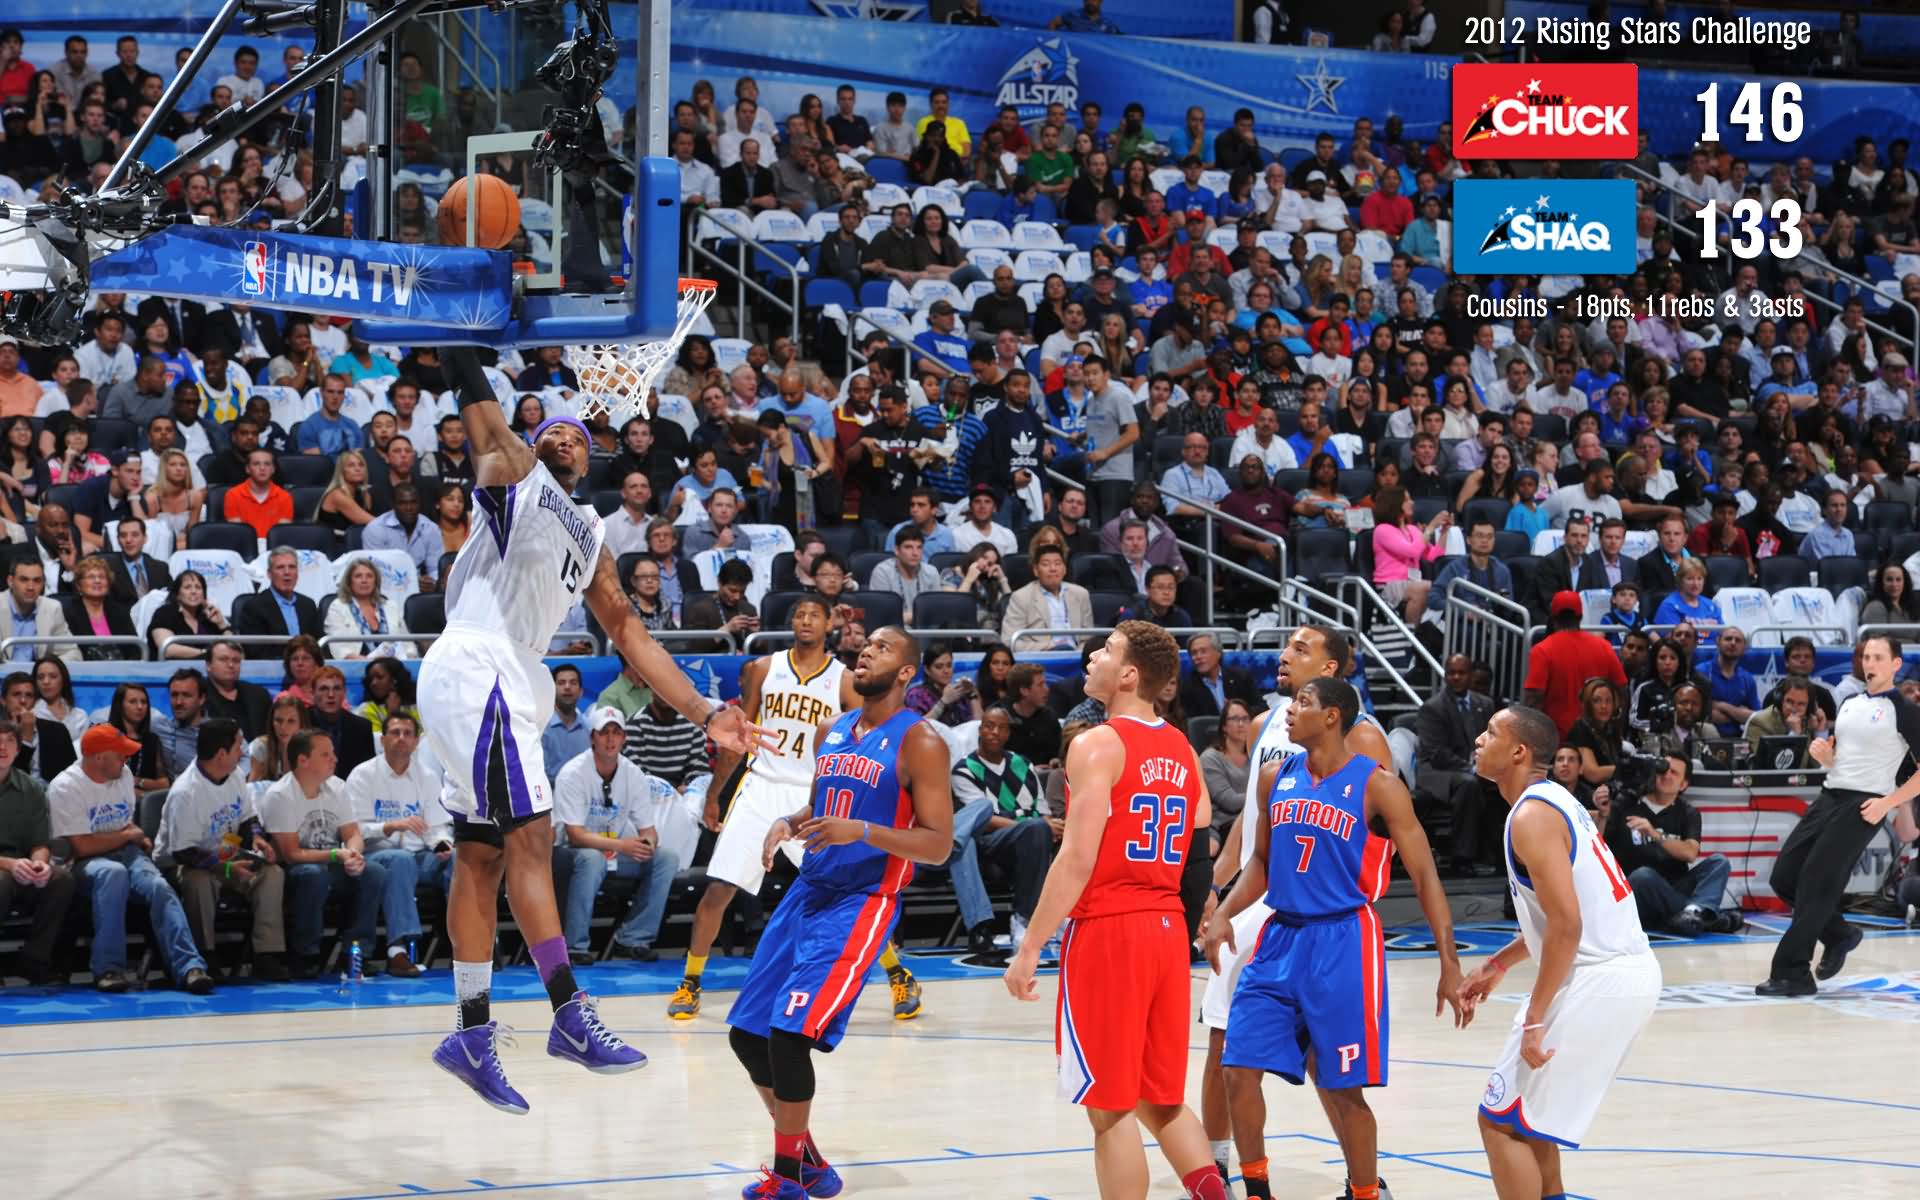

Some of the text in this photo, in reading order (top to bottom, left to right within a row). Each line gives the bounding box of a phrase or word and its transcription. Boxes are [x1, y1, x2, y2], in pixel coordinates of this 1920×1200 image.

[1424, 60, 1449, 80] 115
[284, 251, 418, 306] NBA TV
[560, 547, 582, 594] 15
[777, 728, 806, 760] 24
[816, 752, 886, 788] DETROIT
[1139, 757, 1188, 789] GRIFFIN
[824, 786, 855, 821] 10
[1271, 799, 1358, 842] DETROIT
[1125, 792, 1188, 865] 32
[1295, 834, 1316, 873] 7
[785, 991, 810, 1016] P
[1337, 1043, 1360, 1073] P
